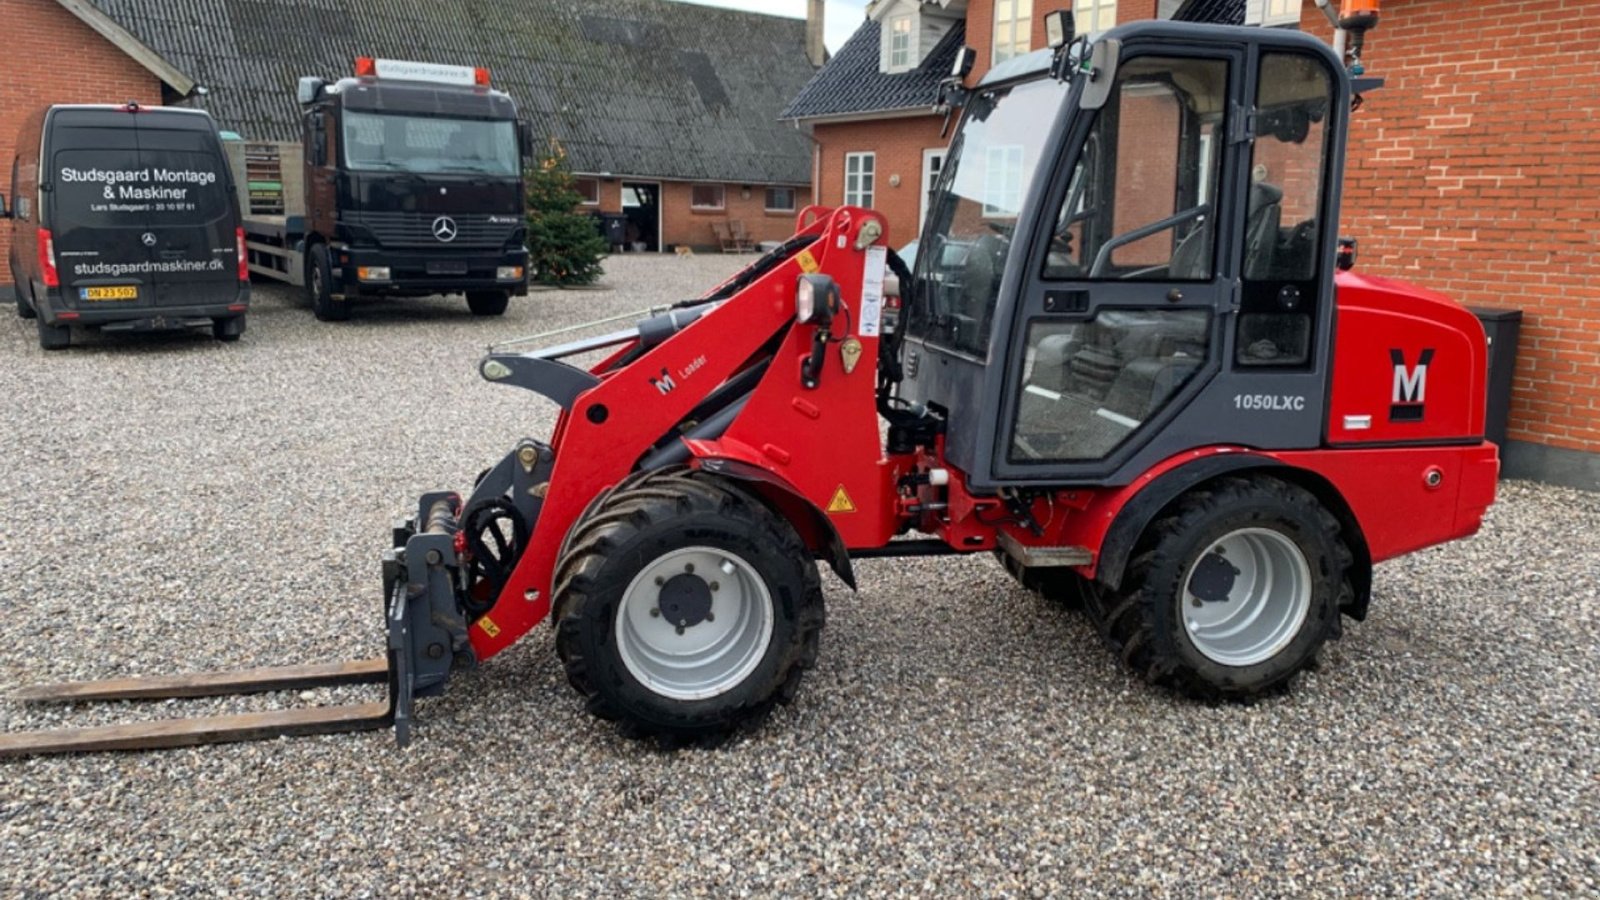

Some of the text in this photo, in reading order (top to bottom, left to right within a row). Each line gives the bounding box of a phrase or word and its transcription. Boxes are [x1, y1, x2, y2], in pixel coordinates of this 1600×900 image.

[61, 168, 216, 186] Studsgaard Montage
[103, 185, 187, 199] & Maskiner
[91, 203, 108, 212] Lars
[74, 259, 224, 276] studsgaardmaskiner.dk
[87, 288, 101, 297] DN
[103, 288, 116, 297] 23
[677, 354, 707, 380] Loader
[1233, 394, 1306, 412] 1050LXC
